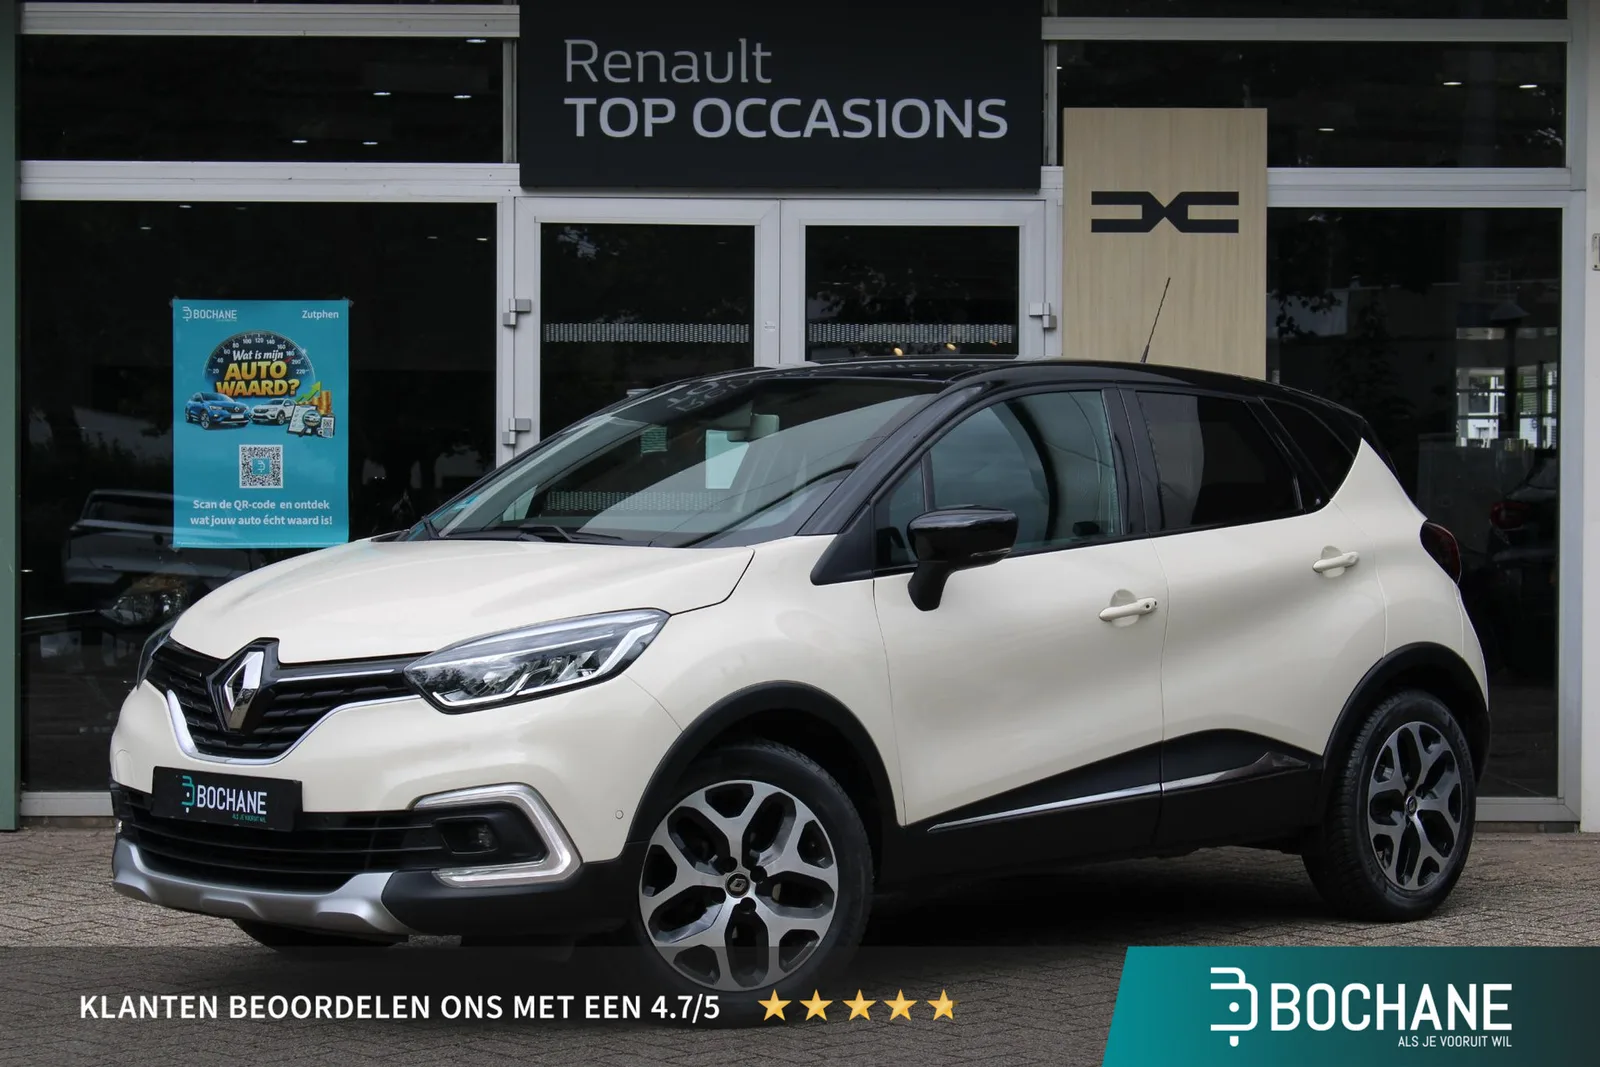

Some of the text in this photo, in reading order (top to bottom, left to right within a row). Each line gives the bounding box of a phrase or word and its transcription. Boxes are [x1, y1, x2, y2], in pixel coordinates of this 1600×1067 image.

[565, 38, 772, 84] Renault
[563, 97, 1008, 139] TOP OCCASIONS
[193, 309, 238, 320] BOCHANE
[301, 309, 339, 321] Zutphen
[232, 349, 284, 361] Wat is mijn
[224, 361, 288, 381] AUTO
[215, 378, 300, 397] WAARD?
[193, 500, 217, 509] Scan
[219, 500, 232, 509] de
[233, 500, 276, 511] QR-code
[294, 500, 330, 509] ontdek
[190, 514, 333, 527] wat jouw auto écht waard is!
[197, 784, 268, 815] BOCHANE
